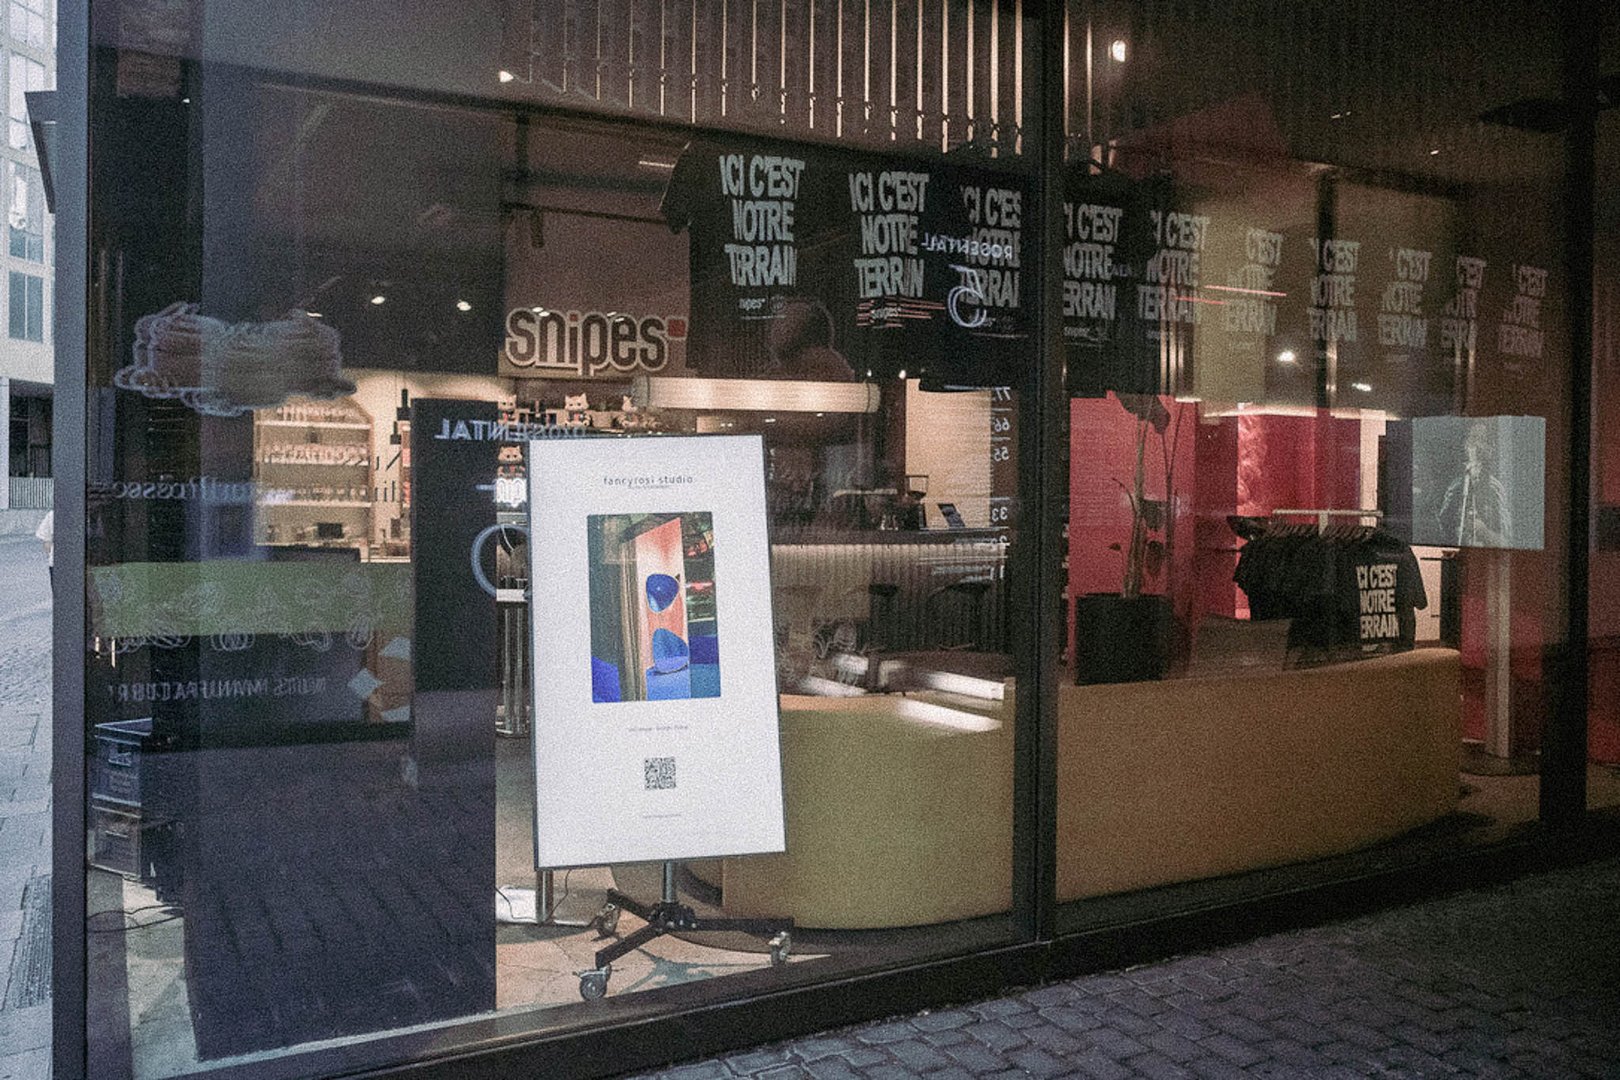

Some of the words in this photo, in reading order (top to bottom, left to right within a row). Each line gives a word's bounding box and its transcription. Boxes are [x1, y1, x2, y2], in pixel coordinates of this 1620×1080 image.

[719, 154, 744, 196] ICI
[848, 172, 874, 213] ICI
[505, 307, 669, 377] snipes
[658, 475, 694, 485] studio
